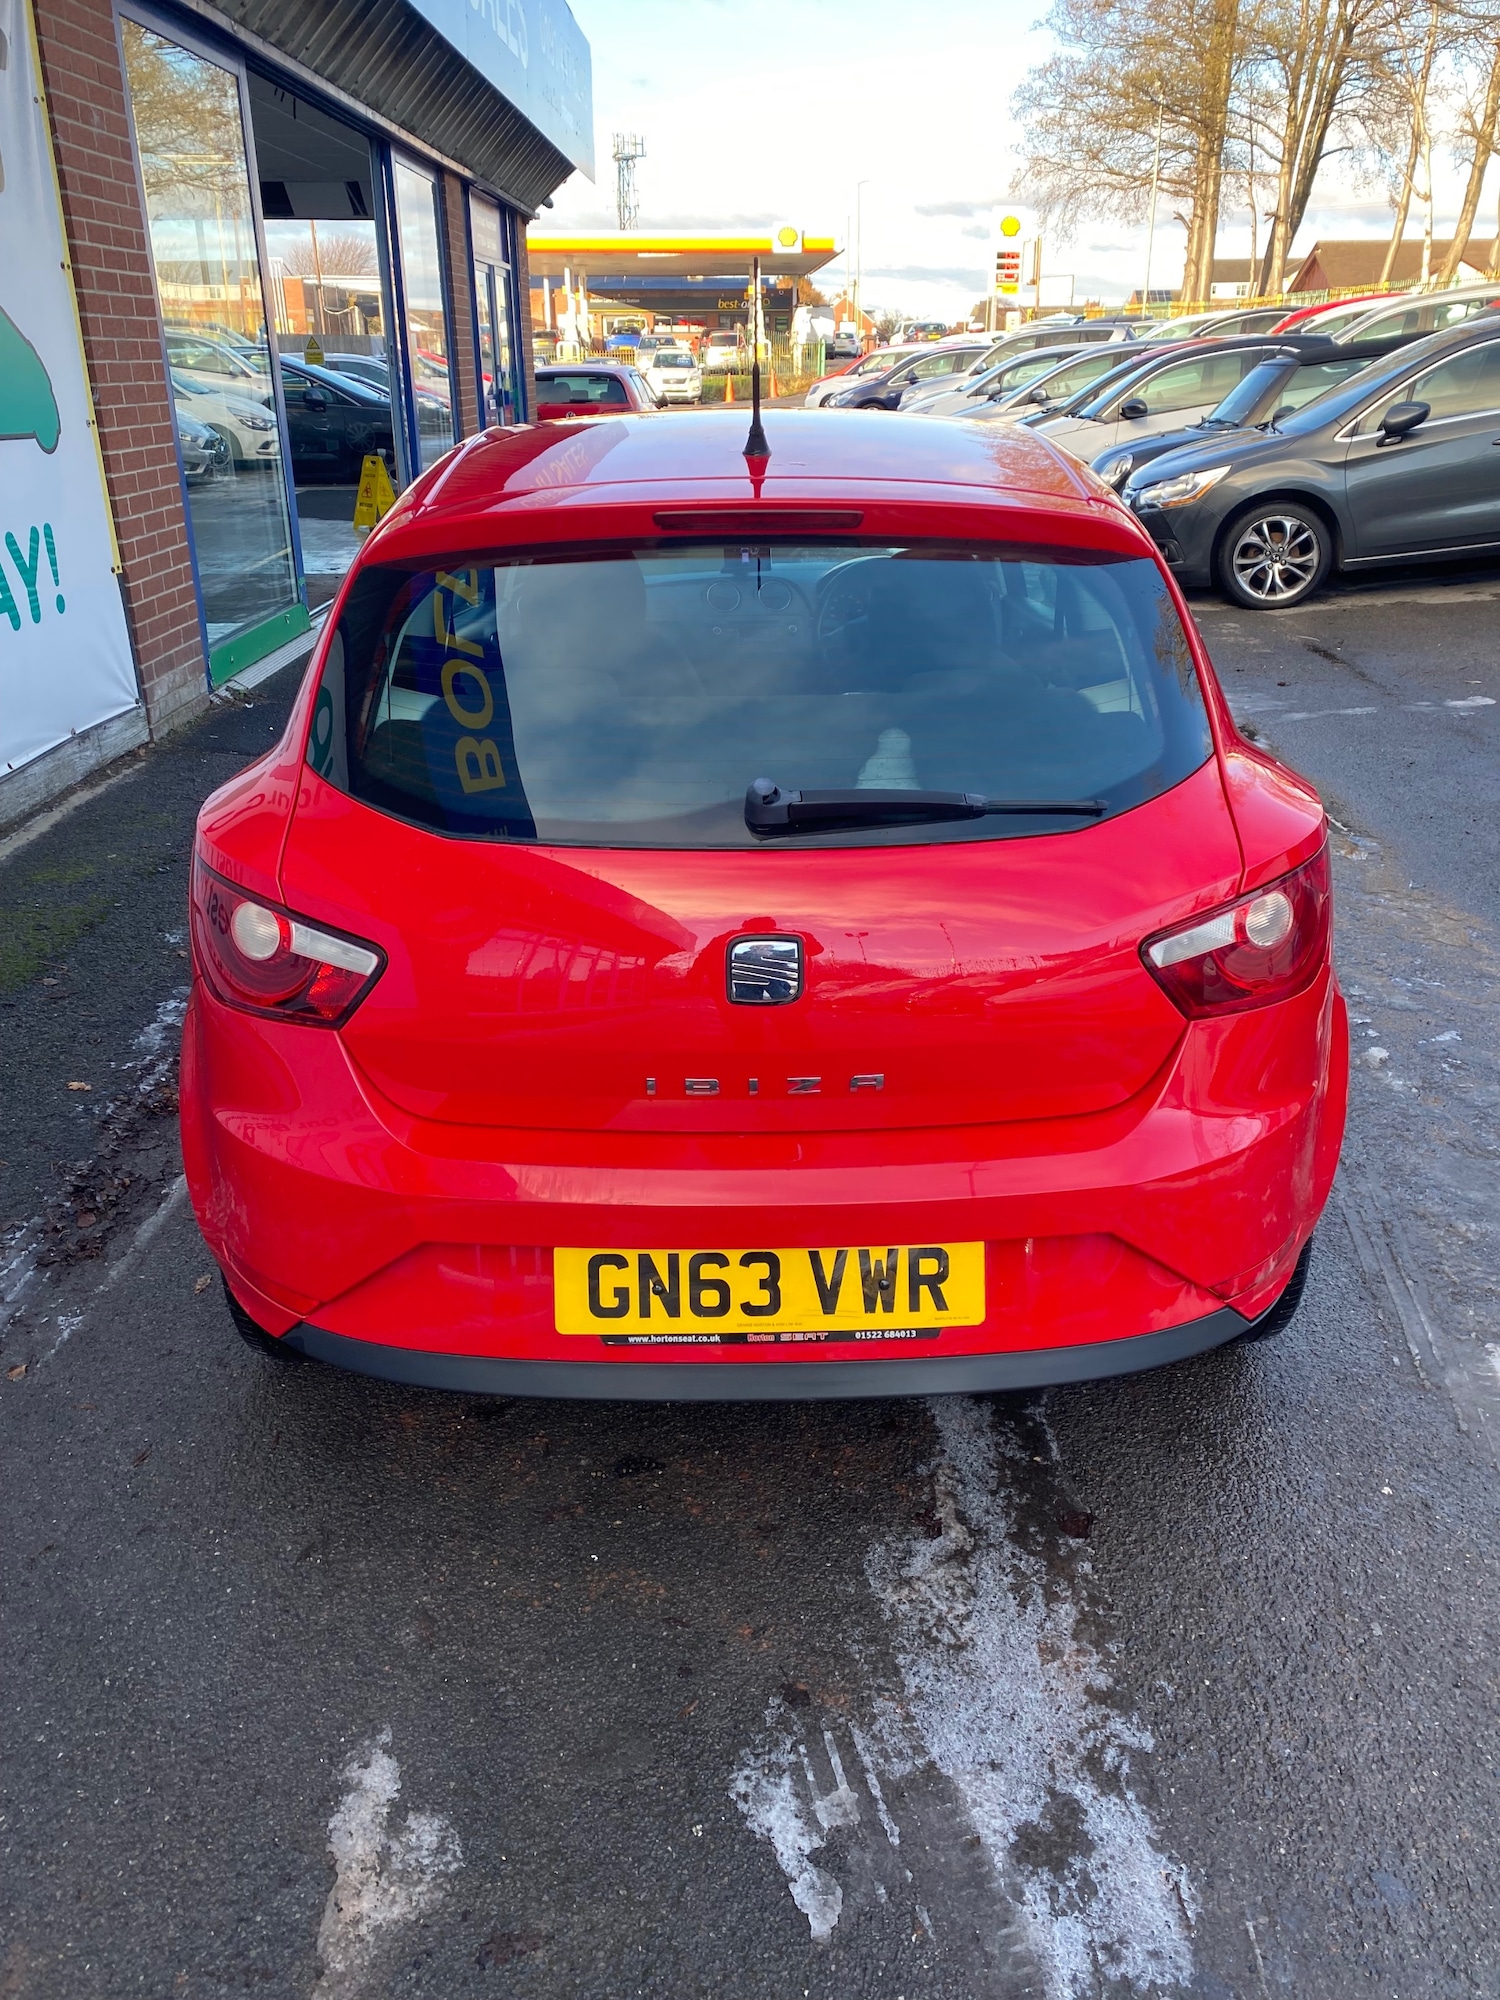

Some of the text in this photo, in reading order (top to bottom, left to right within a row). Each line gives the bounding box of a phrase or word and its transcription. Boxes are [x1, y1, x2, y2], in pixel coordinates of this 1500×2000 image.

[470, 0, 529, 70] LES
[718, 298, 750, 309] best-o
[646, 1073, 885, 1096] IBIZA
[587, 1246, 950, 1320] GN63 VWR
[627, 1333, 722, 1344] www.hortonseat.co.uk
[779, 1332, 830, 1342] SEAT
[854, 1329, 917, 1340] 01522 684013
